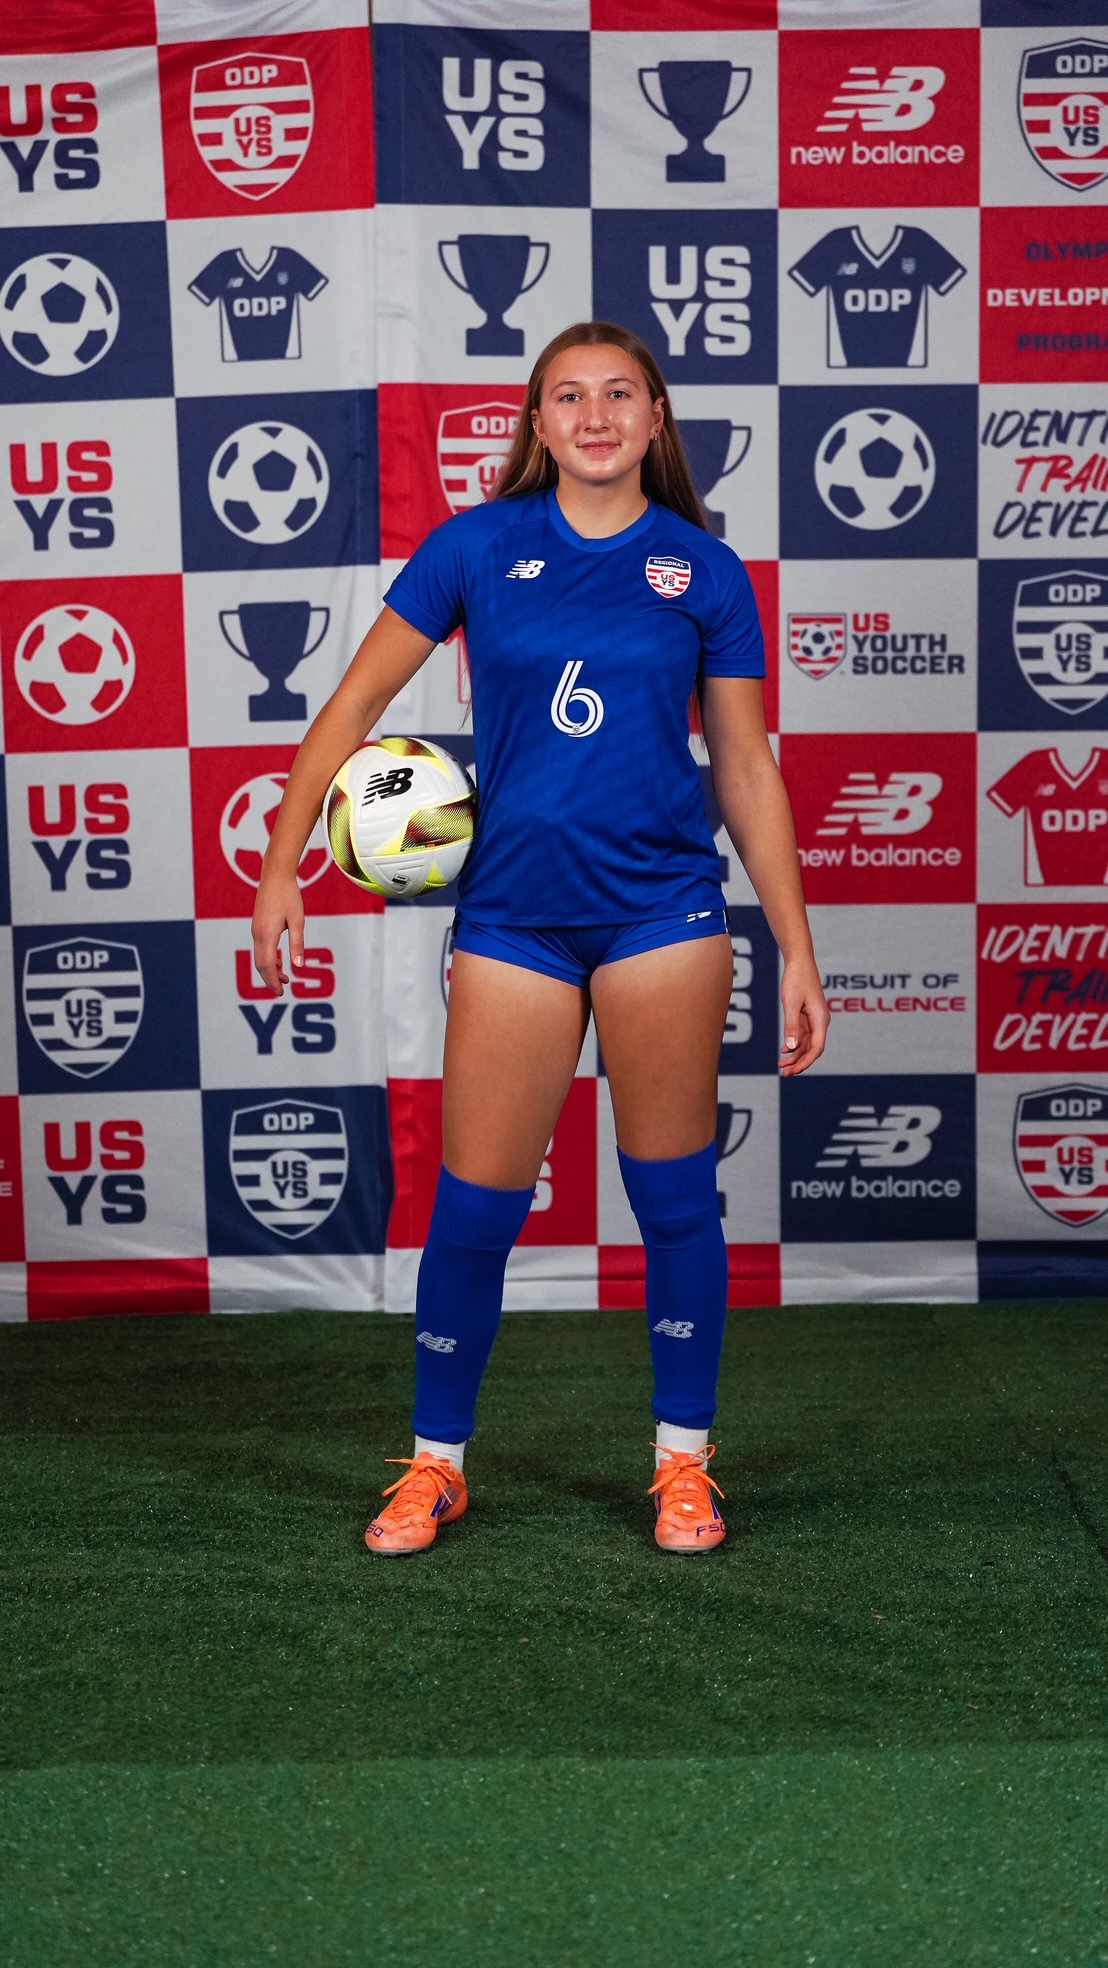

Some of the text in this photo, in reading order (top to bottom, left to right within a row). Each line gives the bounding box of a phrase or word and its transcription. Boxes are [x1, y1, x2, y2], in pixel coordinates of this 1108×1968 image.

[1056, 55, 1108, 74] ODP
[225, 66, 278, 85] ODP
[443, 58, 544, 113] US
[0, 82, 98, 137] US
[1062, 105, 1100, 125] US
[234, 116, 272, 139] US
[1063, 126, 1100, 146] YS
[235, 138, 272, 158] YS
[445, 116, 544, 170] YS
[790, 141, 964, 165] new balance
[0, 138, 100, 192] YS
[649, 246, 751, 299] US
[233, 297, 287, 318] ODP
[844, 289, 912, 312] ODP
[649, 303, 751, 356] YS
[1018, 334, 1108, 352] PROGR
[10, 440, 113, 494] US
[15, 498, 114, 550] YS
[654, 560, 684, 568] REGIONAL
[1048, 583, 1102, 603] ODP
[852, 613, 890, 632] US
[852, 634, 947, 653] YOUTH
[1055, 633, 1091, 653] US
[852, 655, 965, 675] SOCCER
[1056, 653, 1091, 672] YS
[551, 660, 604, 738] 6
[28, 784, 130, 835] US
[1042, 809, 1108, 832] ODP
[33, 839, 131, 890] YS
[852, 844, 962, 866] balance
[57, 951, 109, 970] ODP
[236, 948, 335, 1000] US
[822, 973, 959, 990] RSUIT OF
[65, 999, 102, 1020] US
[67, 1019, 103, 1037] YS
[238, 1003, 336, 1055] YS
[1051, 1099, 1102, 1117] ODP
[263, 1113, 315, 1131] ODP
[44, 1120, 144, 1172] US
[1057, 1146, 1093, 1166] US
[272, 1159, 308, 1180] US
[1059, 1166, 1094, 1185] YS
[273, 1180, 308, 1198] YS
[791, 1176, 961, 1199] new balance
[48, 1175, 146, 1226] YS
